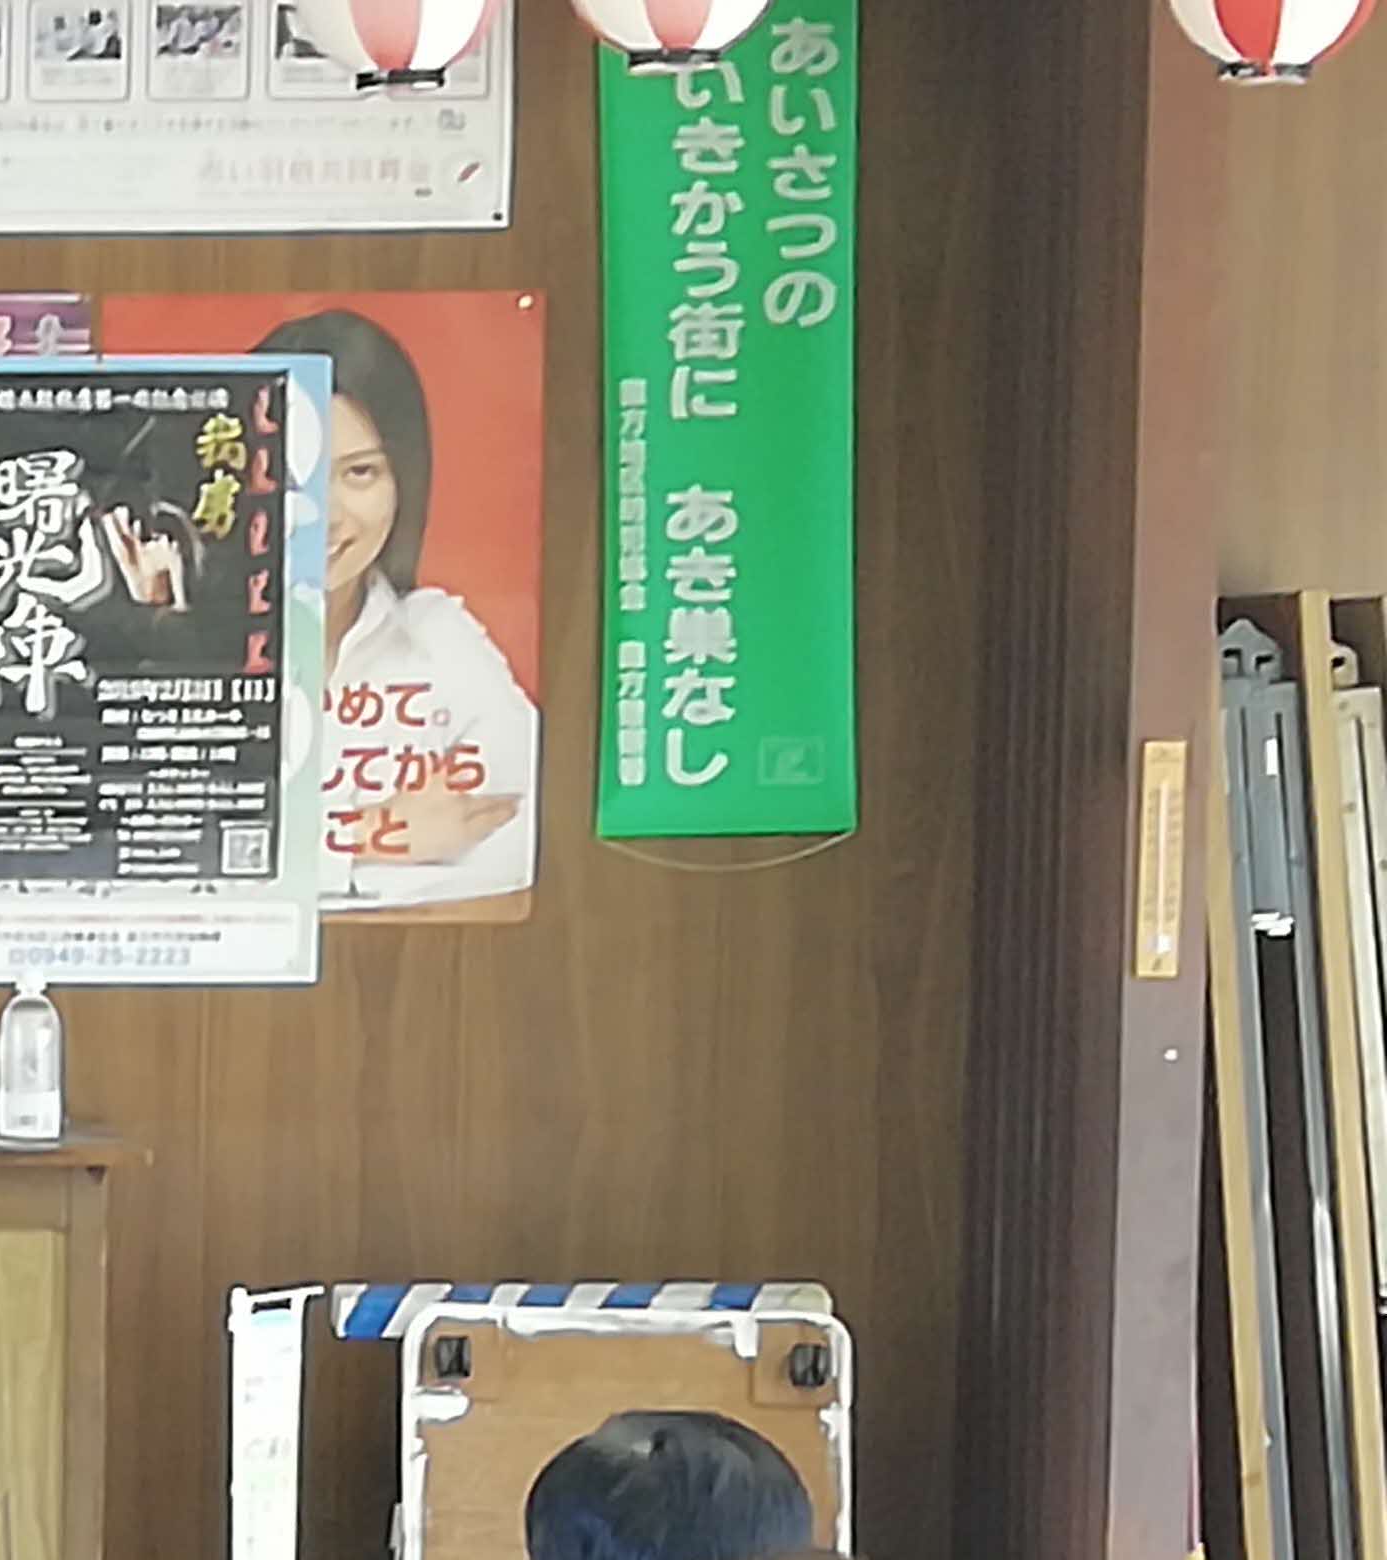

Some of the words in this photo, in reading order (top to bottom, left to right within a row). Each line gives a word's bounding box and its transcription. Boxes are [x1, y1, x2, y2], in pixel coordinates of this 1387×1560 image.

[666, 60, 745, 420] いきかう街に
[763, 17, 840, 328] あいさつの
[660, 484, 739, 787] あき巣なし
